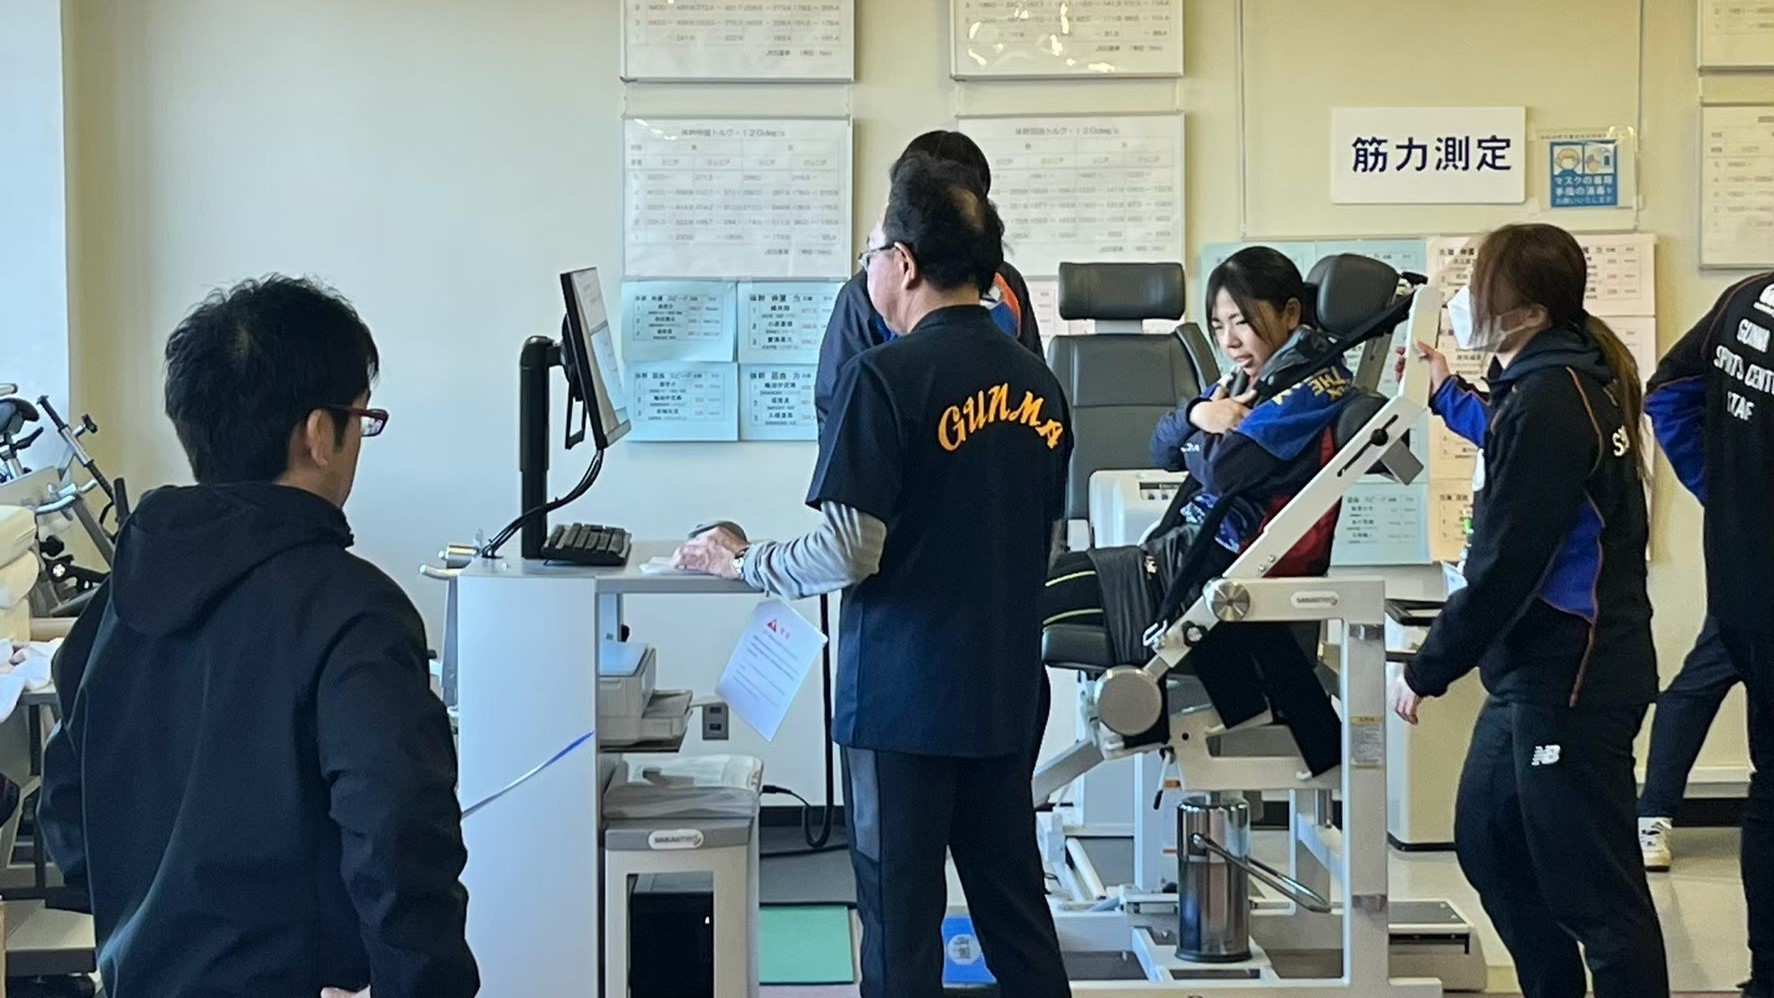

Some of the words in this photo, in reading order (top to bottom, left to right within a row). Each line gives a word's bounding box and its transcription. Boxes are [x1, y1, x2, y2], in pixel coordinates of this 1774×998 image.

[1351, 135, 1512, 173] 筋力測定
[938, 382, 1063, 452] GUNMA
